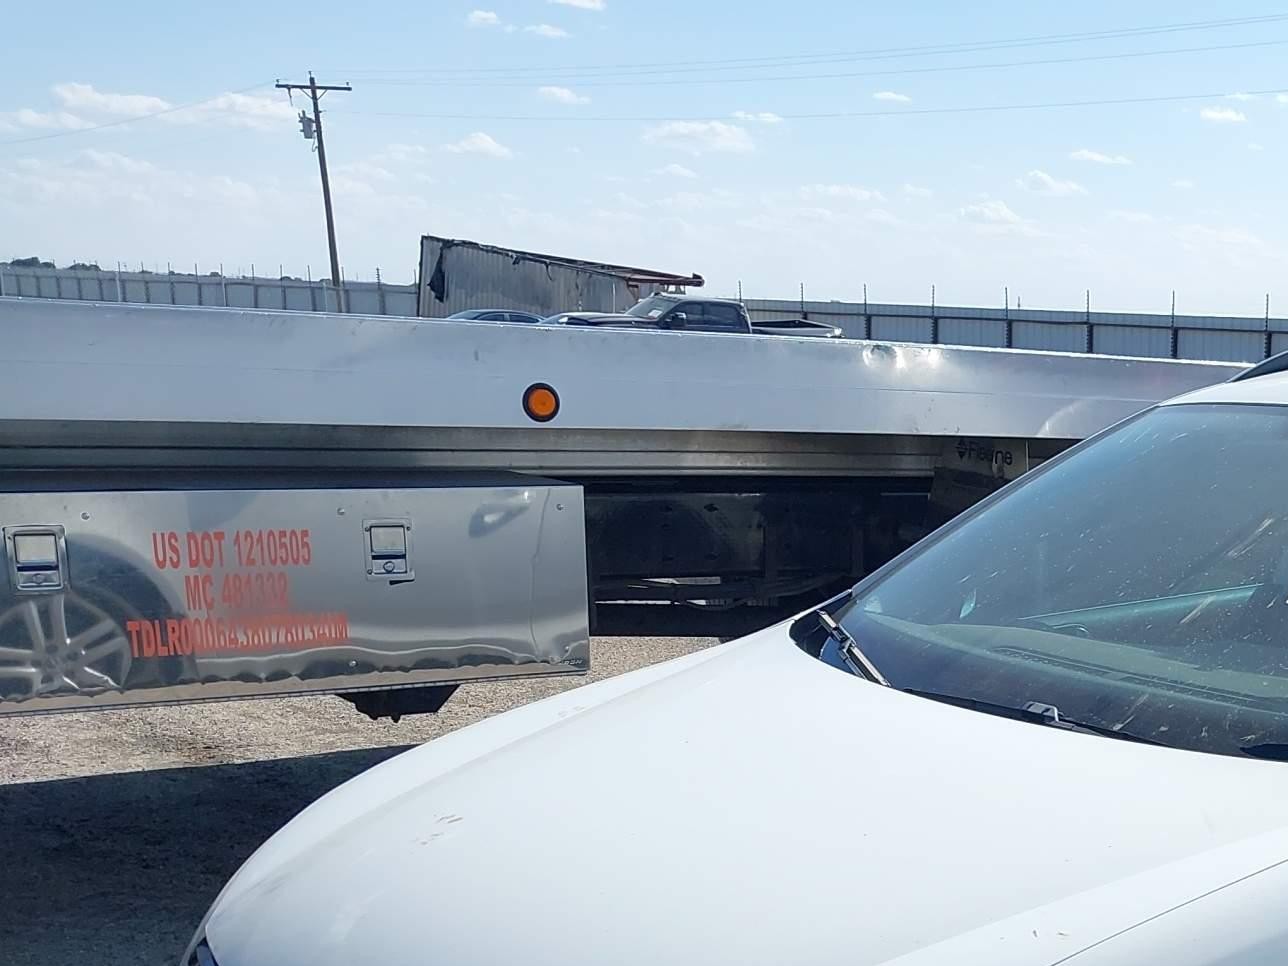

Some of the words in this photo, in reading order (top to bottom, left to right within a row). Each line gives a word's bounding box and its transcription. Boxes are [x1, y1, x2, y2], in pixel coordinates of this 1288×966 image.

[153, 531, 181, 570] US
[186, 531, 225, 569] DOT
[233, 528, 312, 567] 1210505
[184, 573, 215, 611] MC
